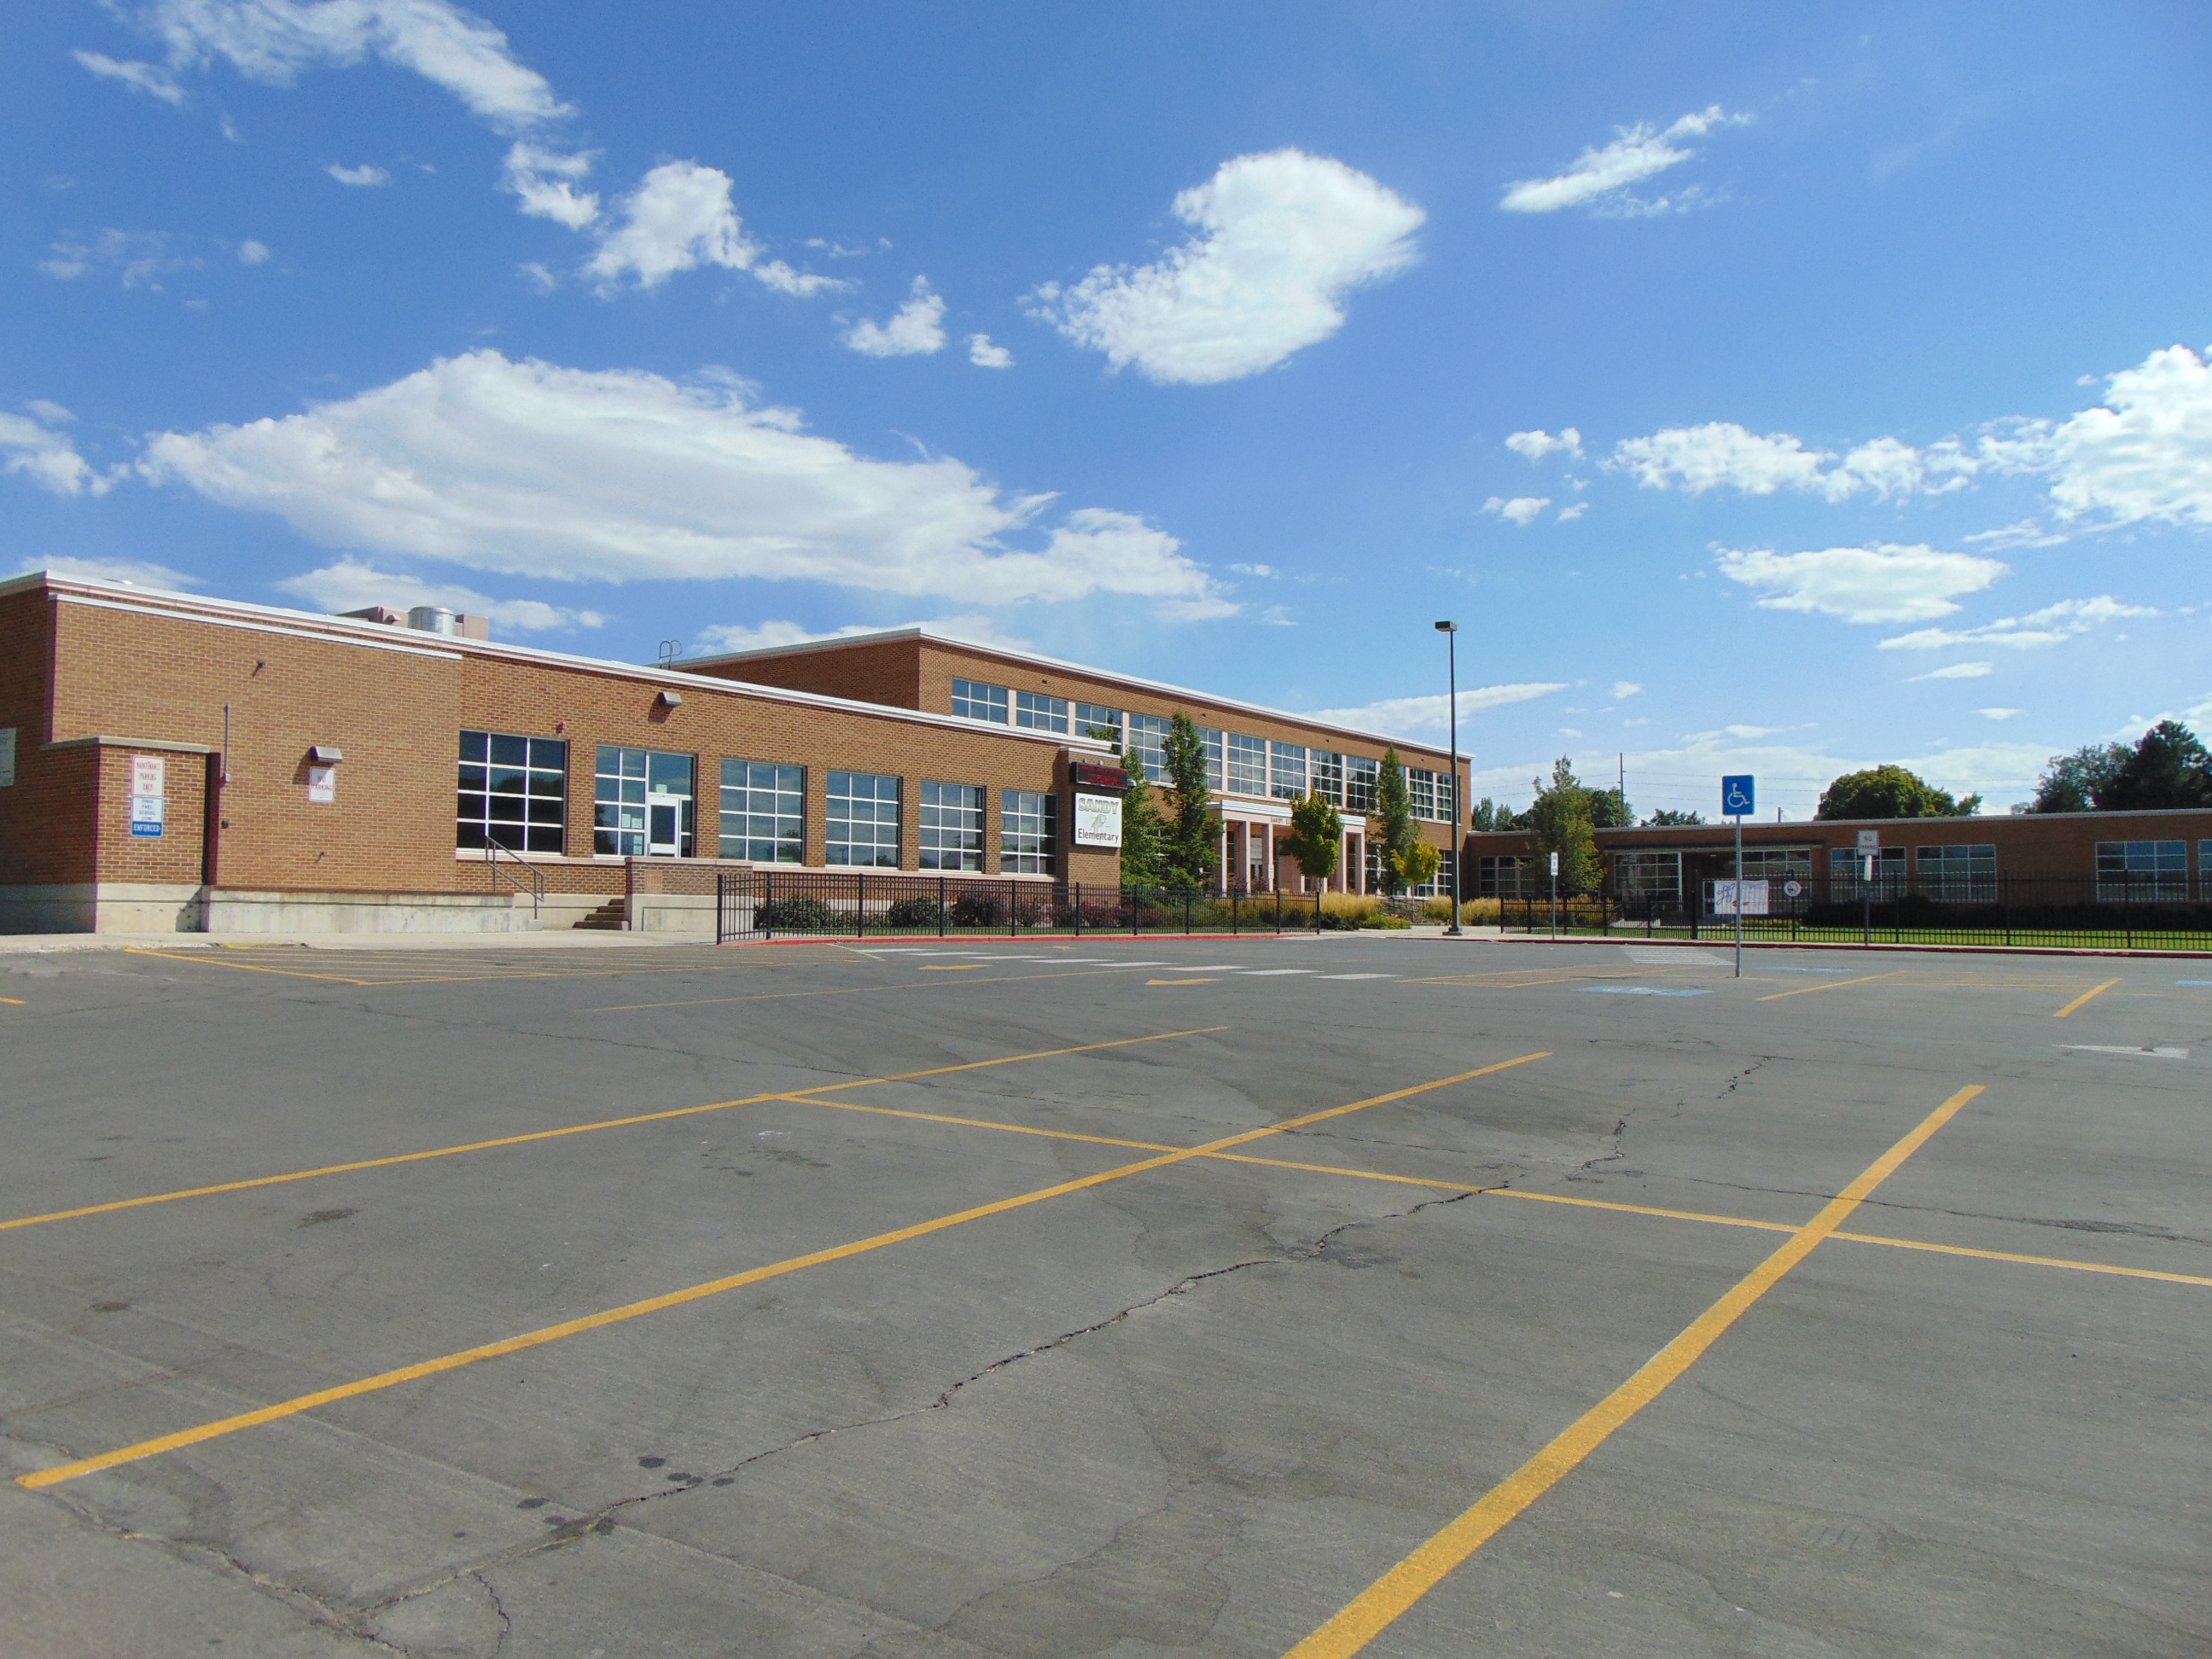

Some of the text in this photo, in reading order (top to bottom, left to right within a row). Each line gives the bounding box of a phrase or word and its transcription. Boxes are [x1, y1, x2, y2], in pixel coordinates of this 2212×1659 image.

[1078, 797, 1120, 815] SANDY
[134, 824, 160, 832] ENFORCED
[1078, 828, 1120, 844] Elementary
